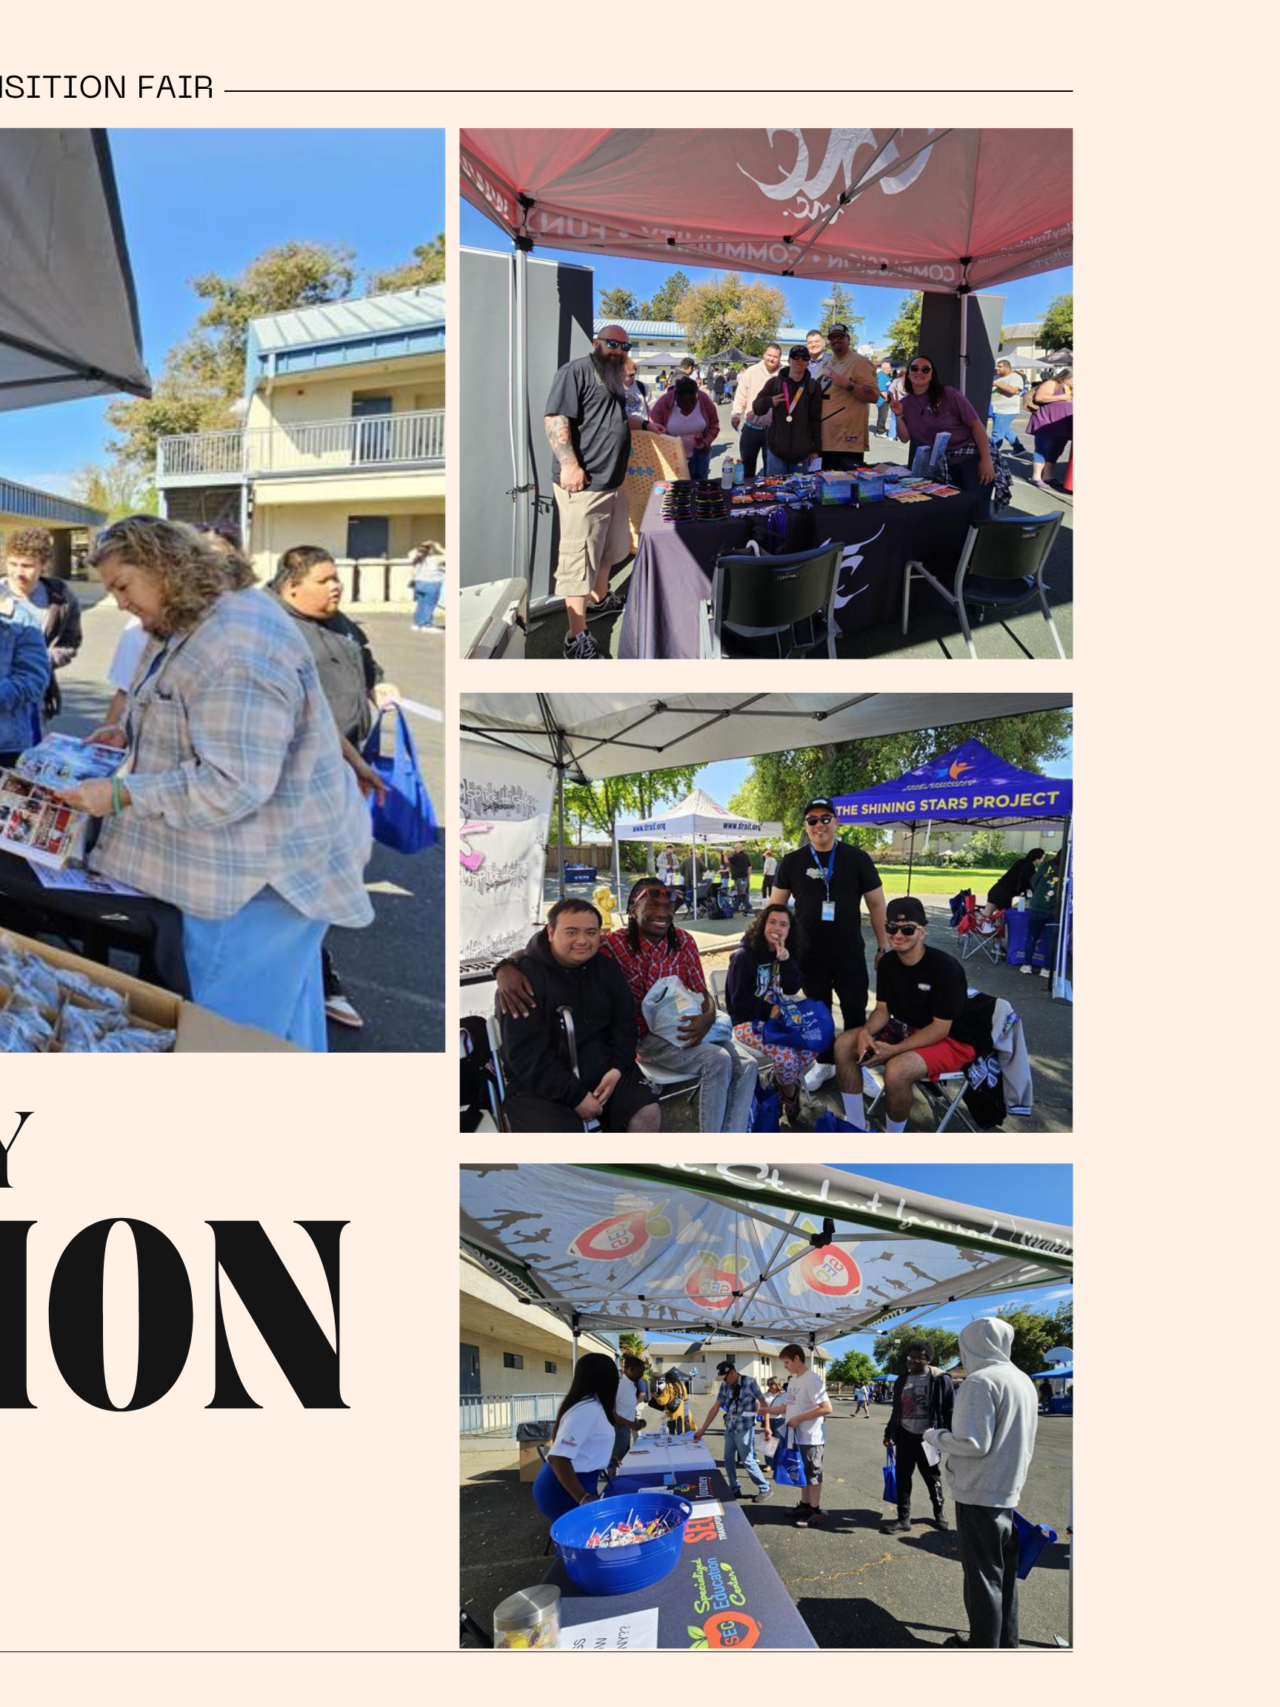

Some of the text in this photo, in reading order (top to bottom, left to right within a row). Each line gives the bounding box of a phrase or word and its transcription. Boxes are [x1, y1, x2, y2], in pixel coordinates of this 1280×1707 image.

[836, 791, 1060, 816] THE SHINING STARS PROJECT
[694, 1558, 711, 1614] Specialized
[708, 1557, 731, 1612] Education
[720, 1620, 741, 1647] SEC
